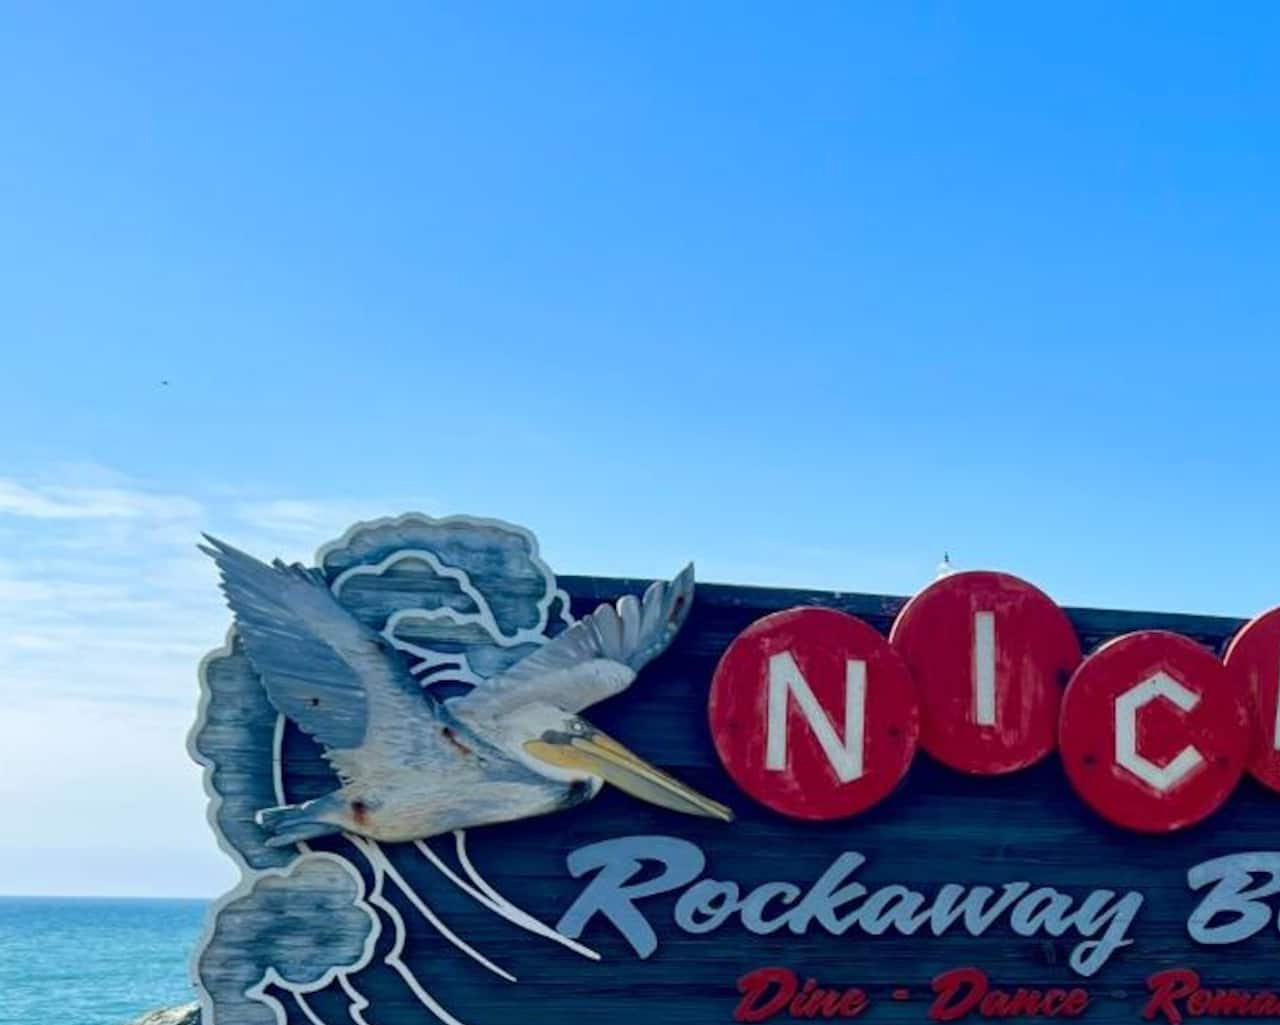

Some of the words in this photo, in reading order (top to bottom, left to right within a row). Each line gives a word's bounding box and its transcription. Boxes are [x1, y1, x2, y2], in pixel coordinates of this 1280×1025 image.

[555, 835, 1144, 977] Rockaway
[733, 967, 869, 1023] Dine
[928, 967, 1091, 1023] Dance
